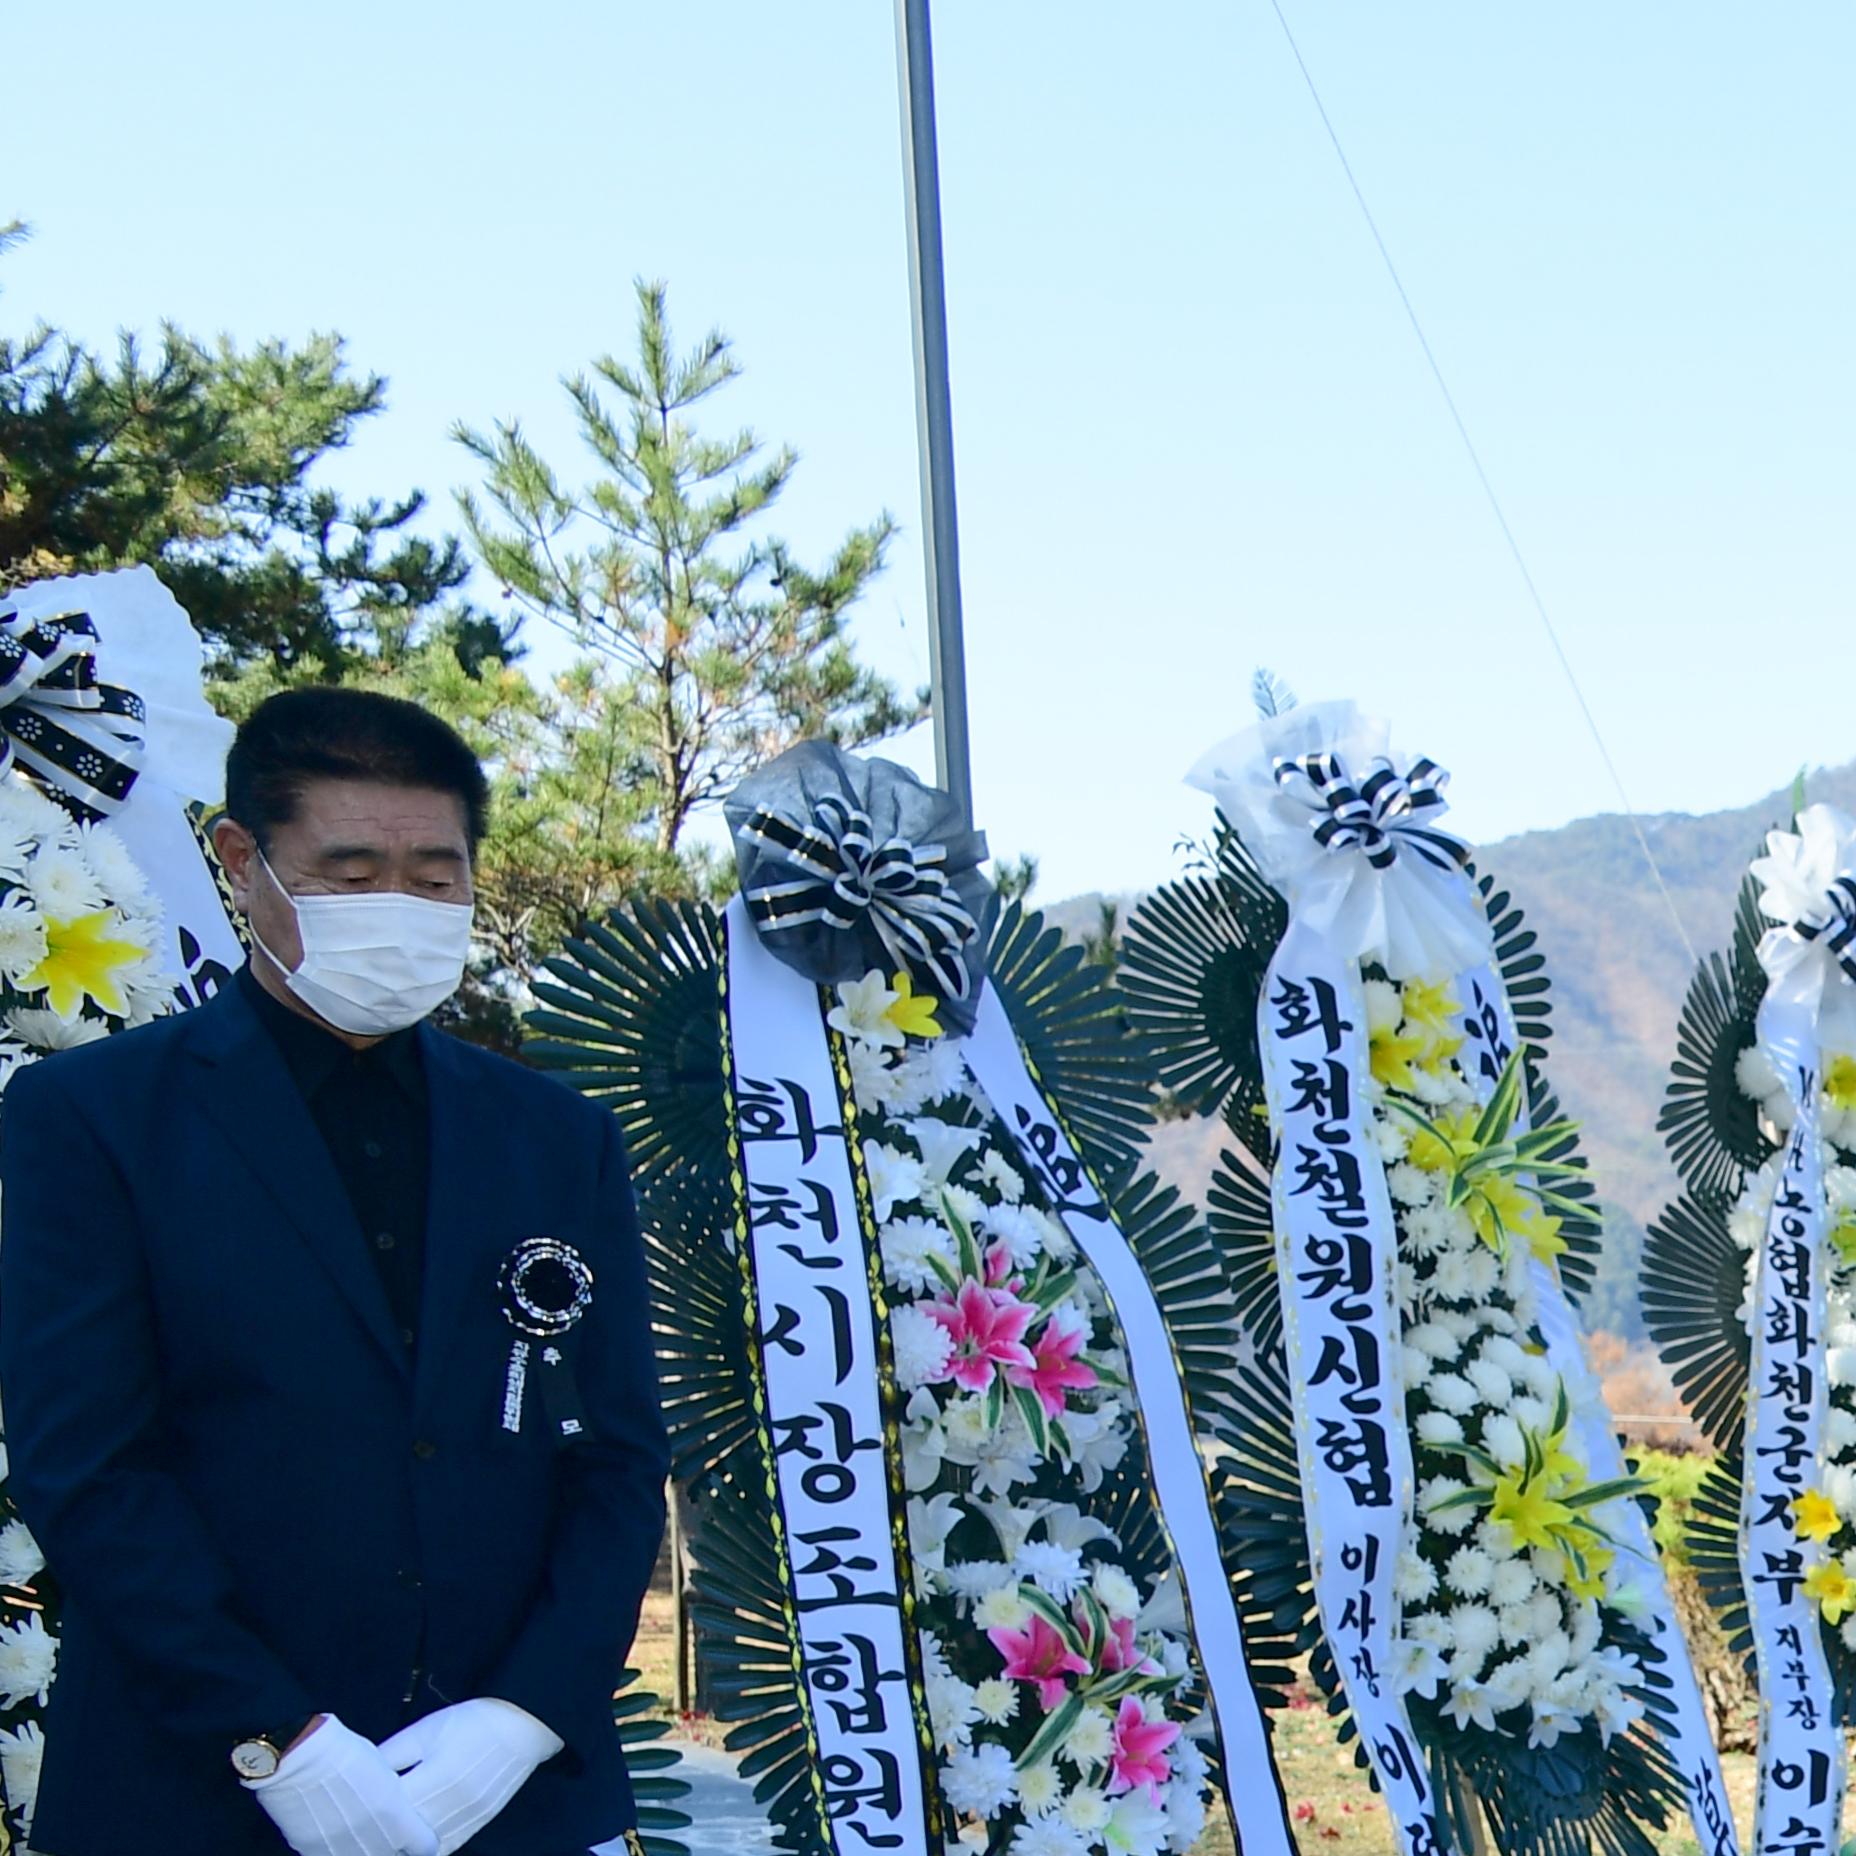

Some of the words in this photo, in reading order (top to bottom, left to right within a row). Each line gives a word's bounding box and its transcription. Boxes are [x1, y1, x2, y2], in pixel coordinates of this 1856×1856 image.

[737, 1074, 905, 1848] 화천시장조합원
[1270, 976, 1393, 1508] 화천철원신협
[1337, 1533, 1381, 1698] 이사장
[1774, 1623, 1821, 1731] 지부장
